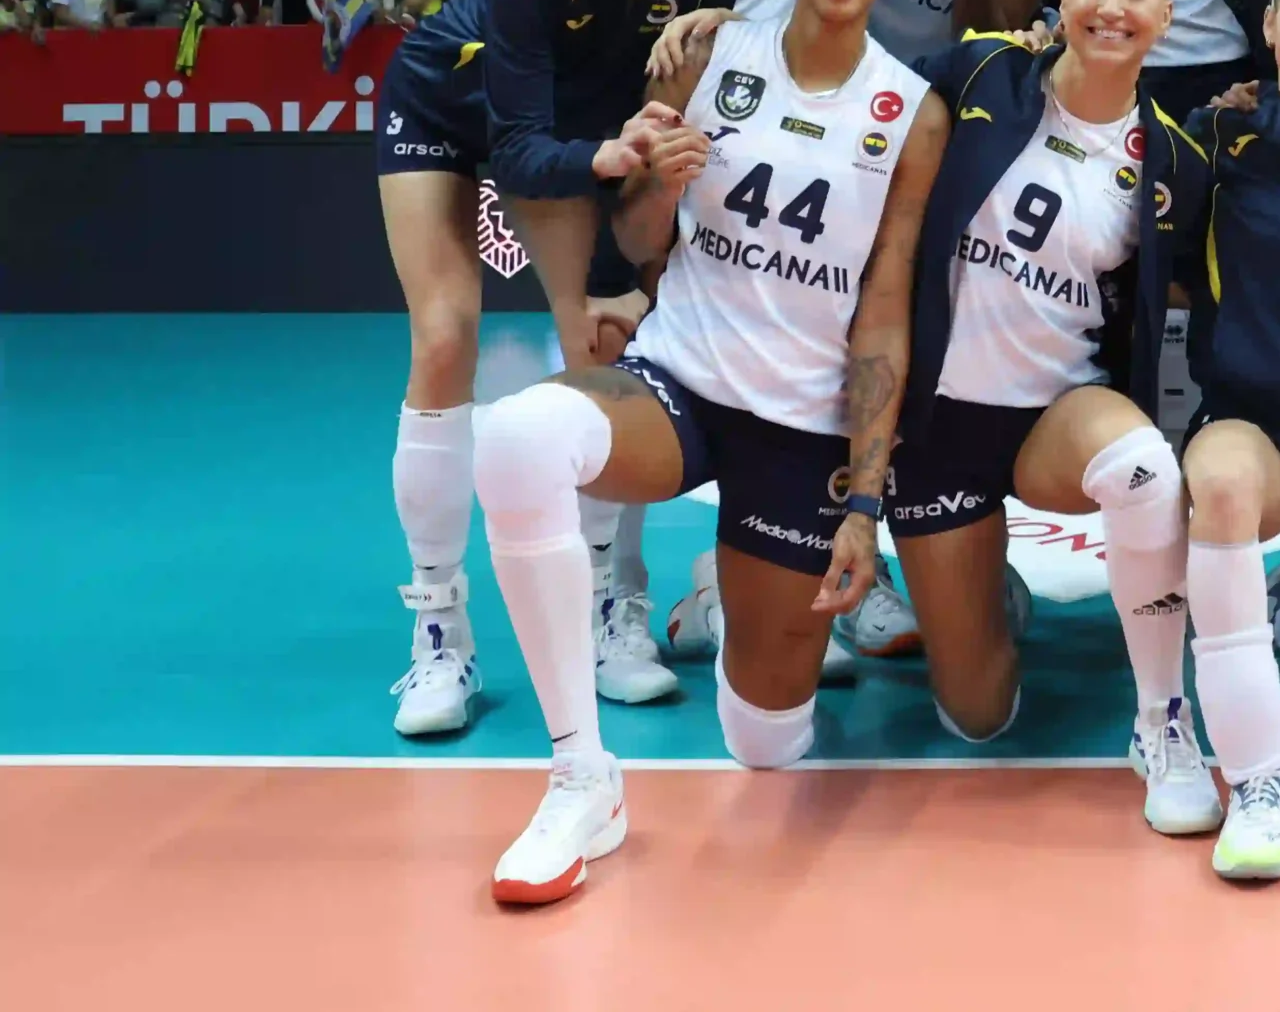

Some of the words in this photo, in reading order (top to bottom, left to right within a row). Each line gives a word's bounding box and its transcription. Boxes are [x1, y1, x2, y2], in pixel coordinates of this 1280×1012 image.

[734, 74, 755, 85] CEV
[724, 162, 831, 245] 44
[1006, 182, 1062, 253] 9
[1128, 471, 1158, 490] adidas
